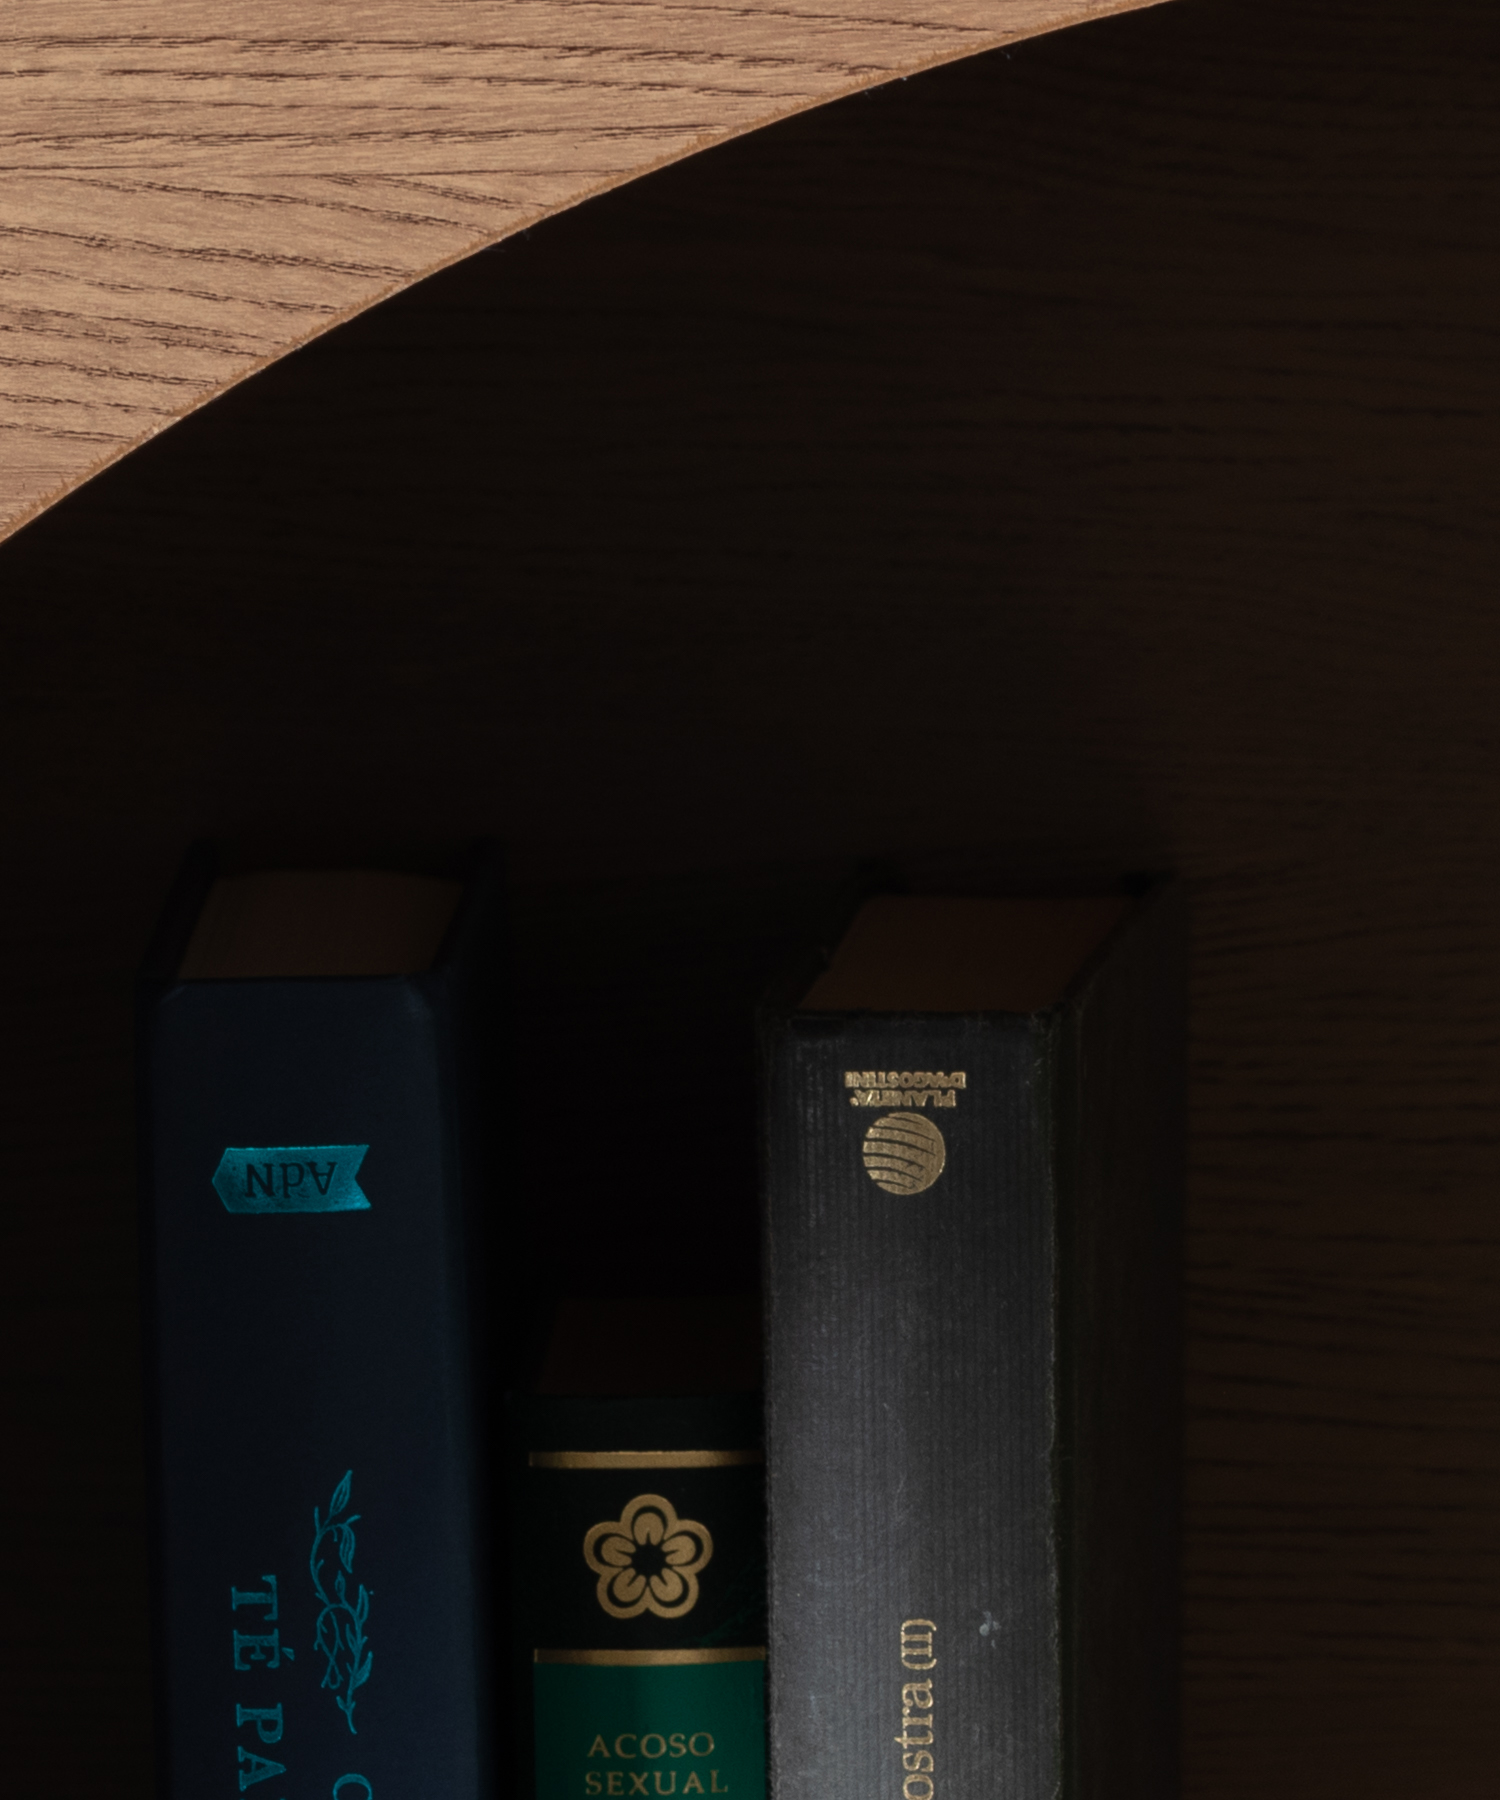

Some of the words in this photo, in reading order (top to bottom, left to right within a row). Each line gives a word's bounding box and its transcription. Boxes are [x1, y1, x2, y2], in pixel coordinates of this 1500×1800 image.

[245, 1161, 338, 1199] AdN
[231, 1574, 296, 1672] TÉ
[900, 1617, 938, 1671] (II)
[586, 1730, 716, 1760] ACOSO
[584, 1768, 729, 1797] SEXUAL
